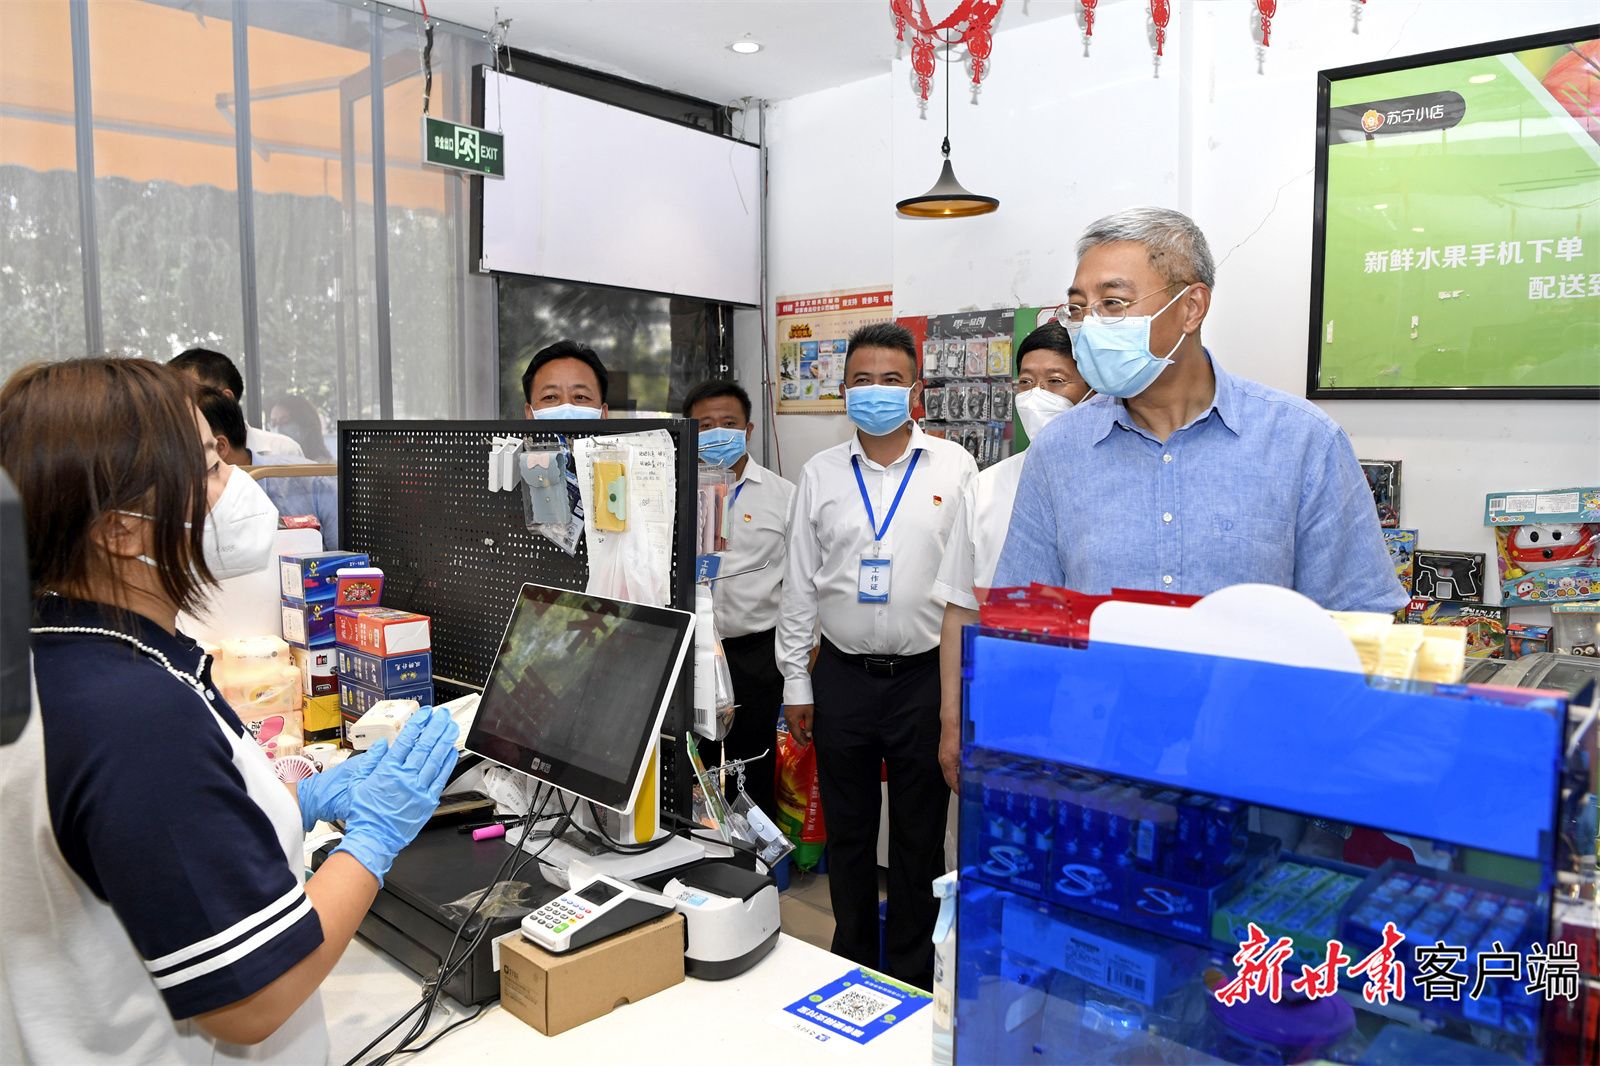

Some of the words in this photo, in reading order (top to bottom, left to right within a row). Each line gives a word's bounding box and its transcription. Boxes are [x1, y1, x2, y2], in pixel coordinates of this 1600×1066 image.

[1386, 105, 1444, 125] 苏宁小店
[434, 135, 454, 151] 安全出口
[480, 145, 498, 160] EXIT
[1363, 236, 1584, 274] 新鲜水果手机下单
[870, 566, 879, 591] 工作证
[1410, 602, 1425, 610] LW
